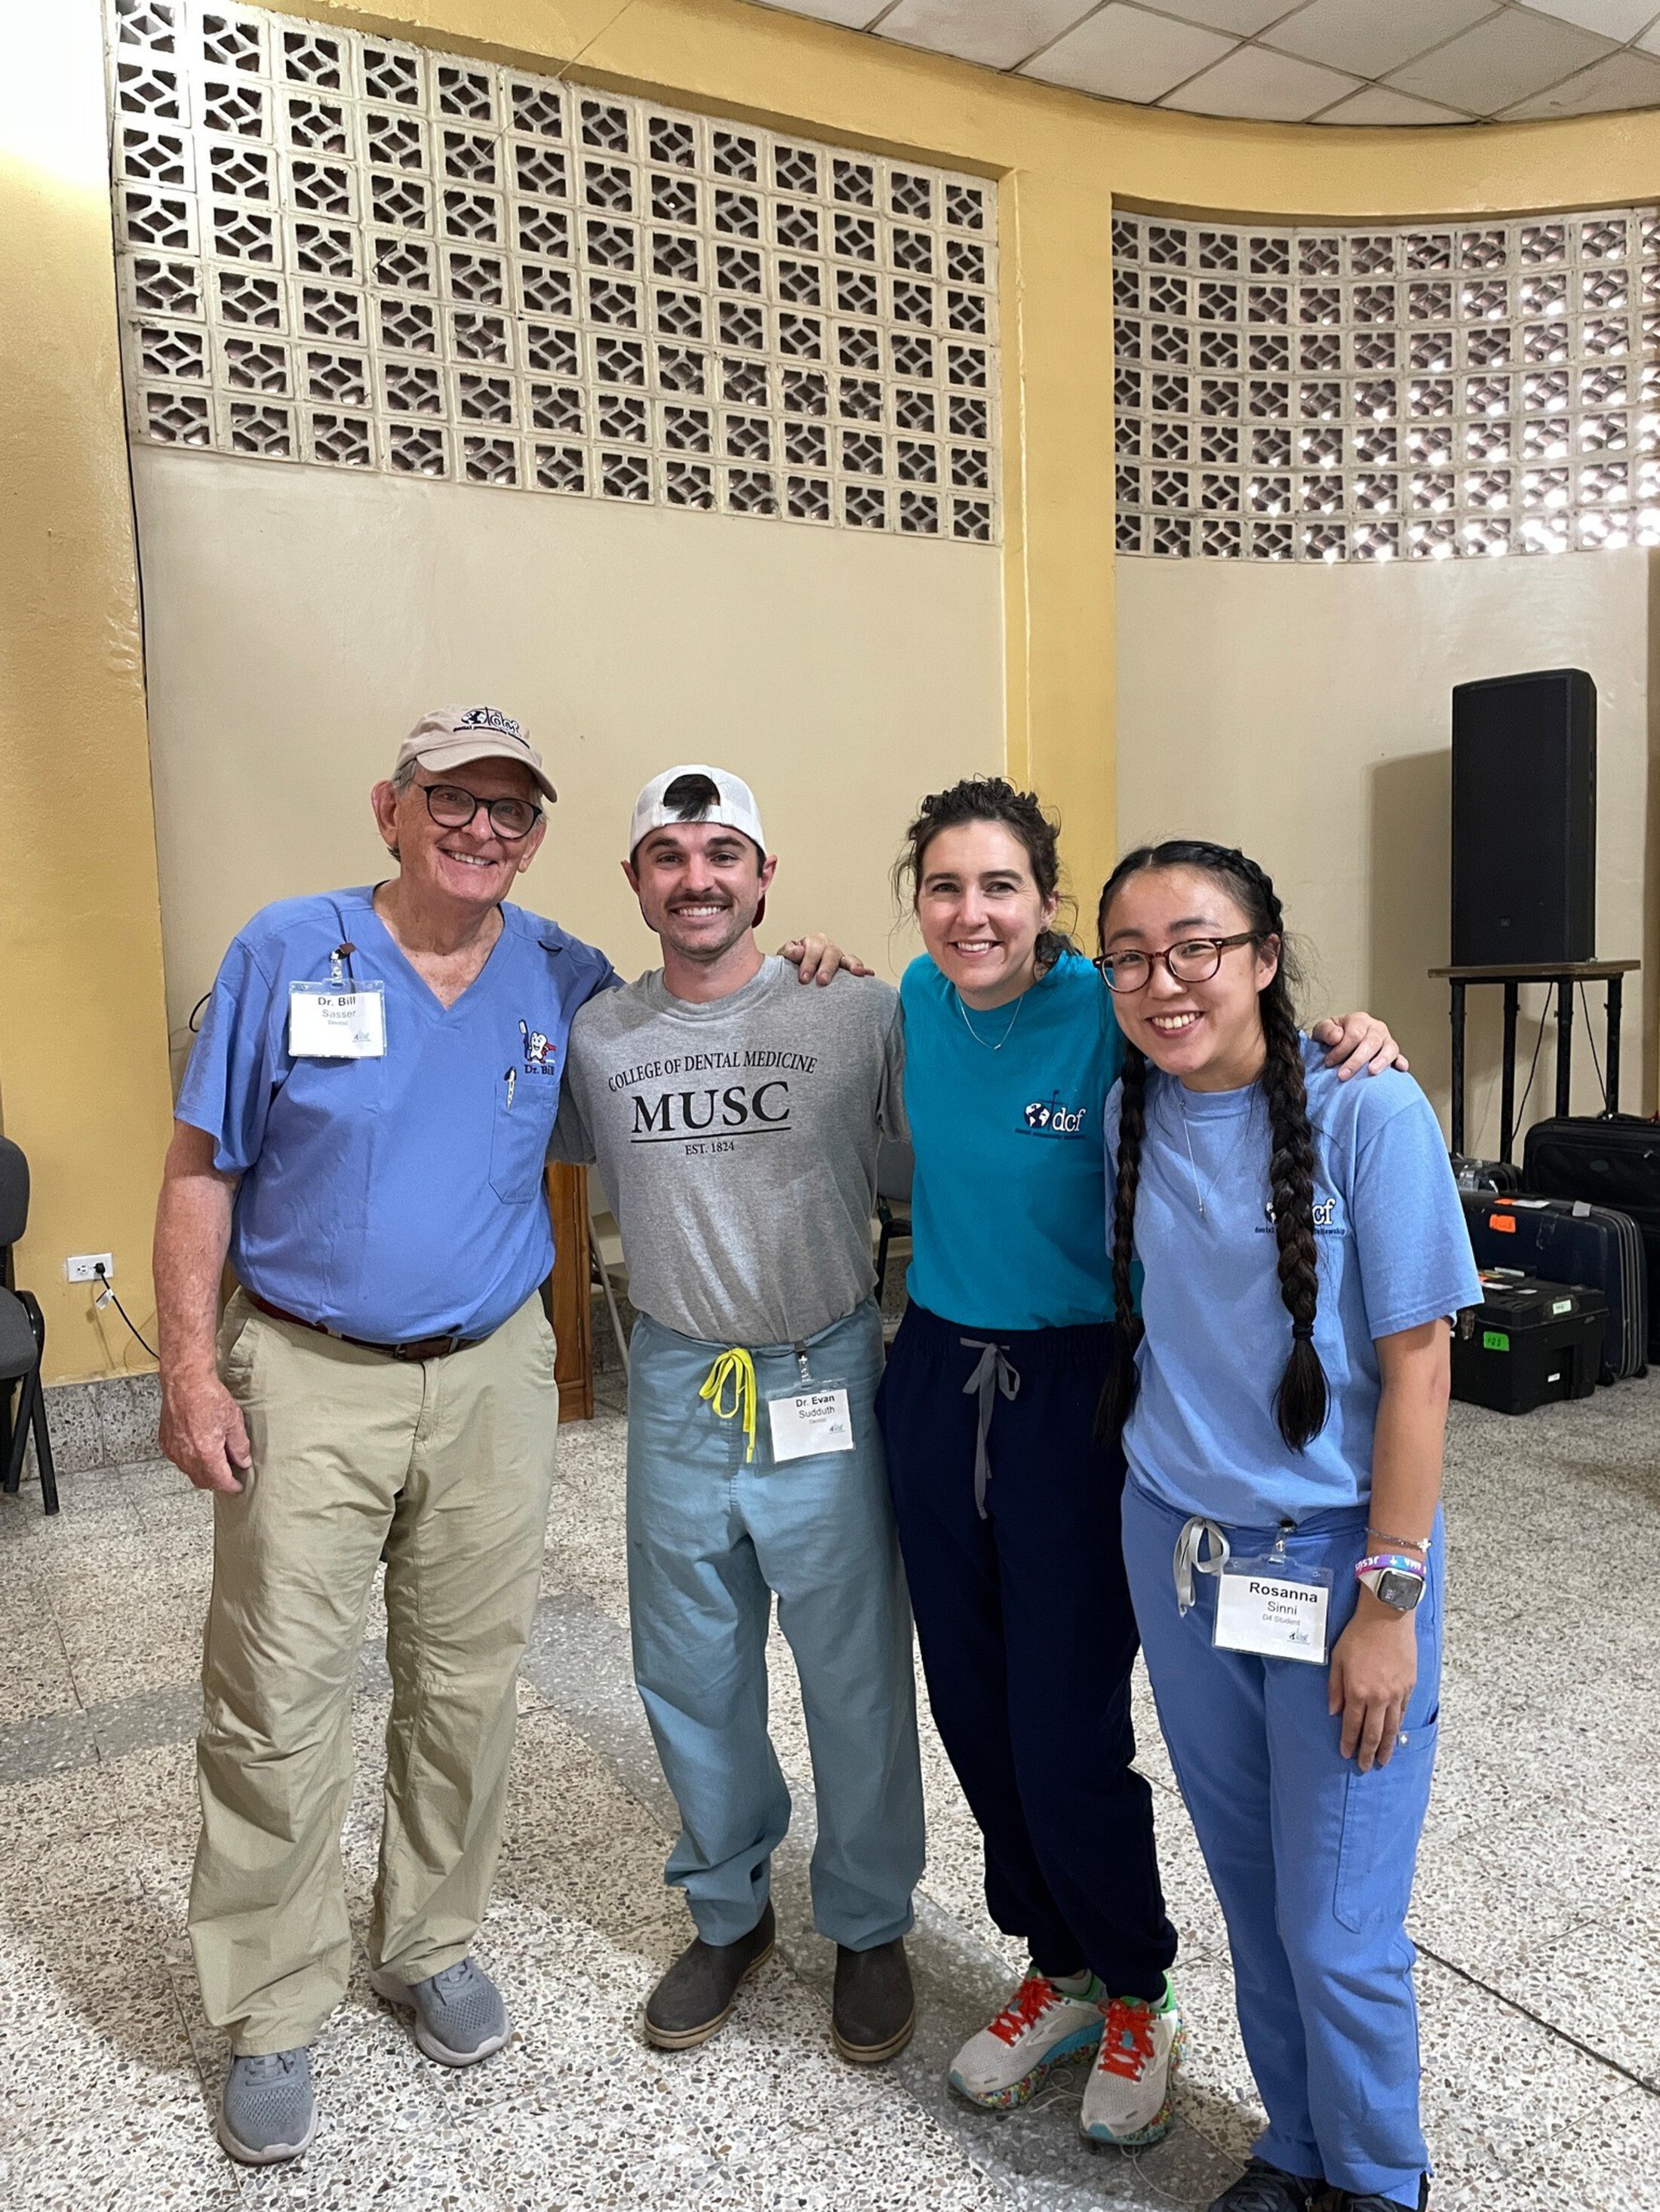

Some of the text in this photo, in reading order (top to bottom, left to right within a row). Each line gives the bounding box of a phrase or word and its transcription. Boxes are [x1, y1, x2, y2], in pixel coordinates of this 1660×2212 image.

[318, 996, 356, 1006] Dr. Bill
[321, 1009, 356, 1018] Sasser
[524, 1065, 555, 1076] Dr. Bill
[607, 1051, 818, 1092] COLLEGE OF DENTAL MEDICINE
[631, 1080, 791, 1134] MUSC
[1052, 1107, 1087, 1132] dcf
[685, 1141, 735, 1155] EST. 1824
[796, 1395, 835, 1408] Dr. Evan
[799, 1406, 835, 1419] Sudduth
[1250, 1582, 1317, 1603] Rosanna
[1268, 1601, 1297, 1615] Sinni
[1274, 1615, 1300, 1627] Student
